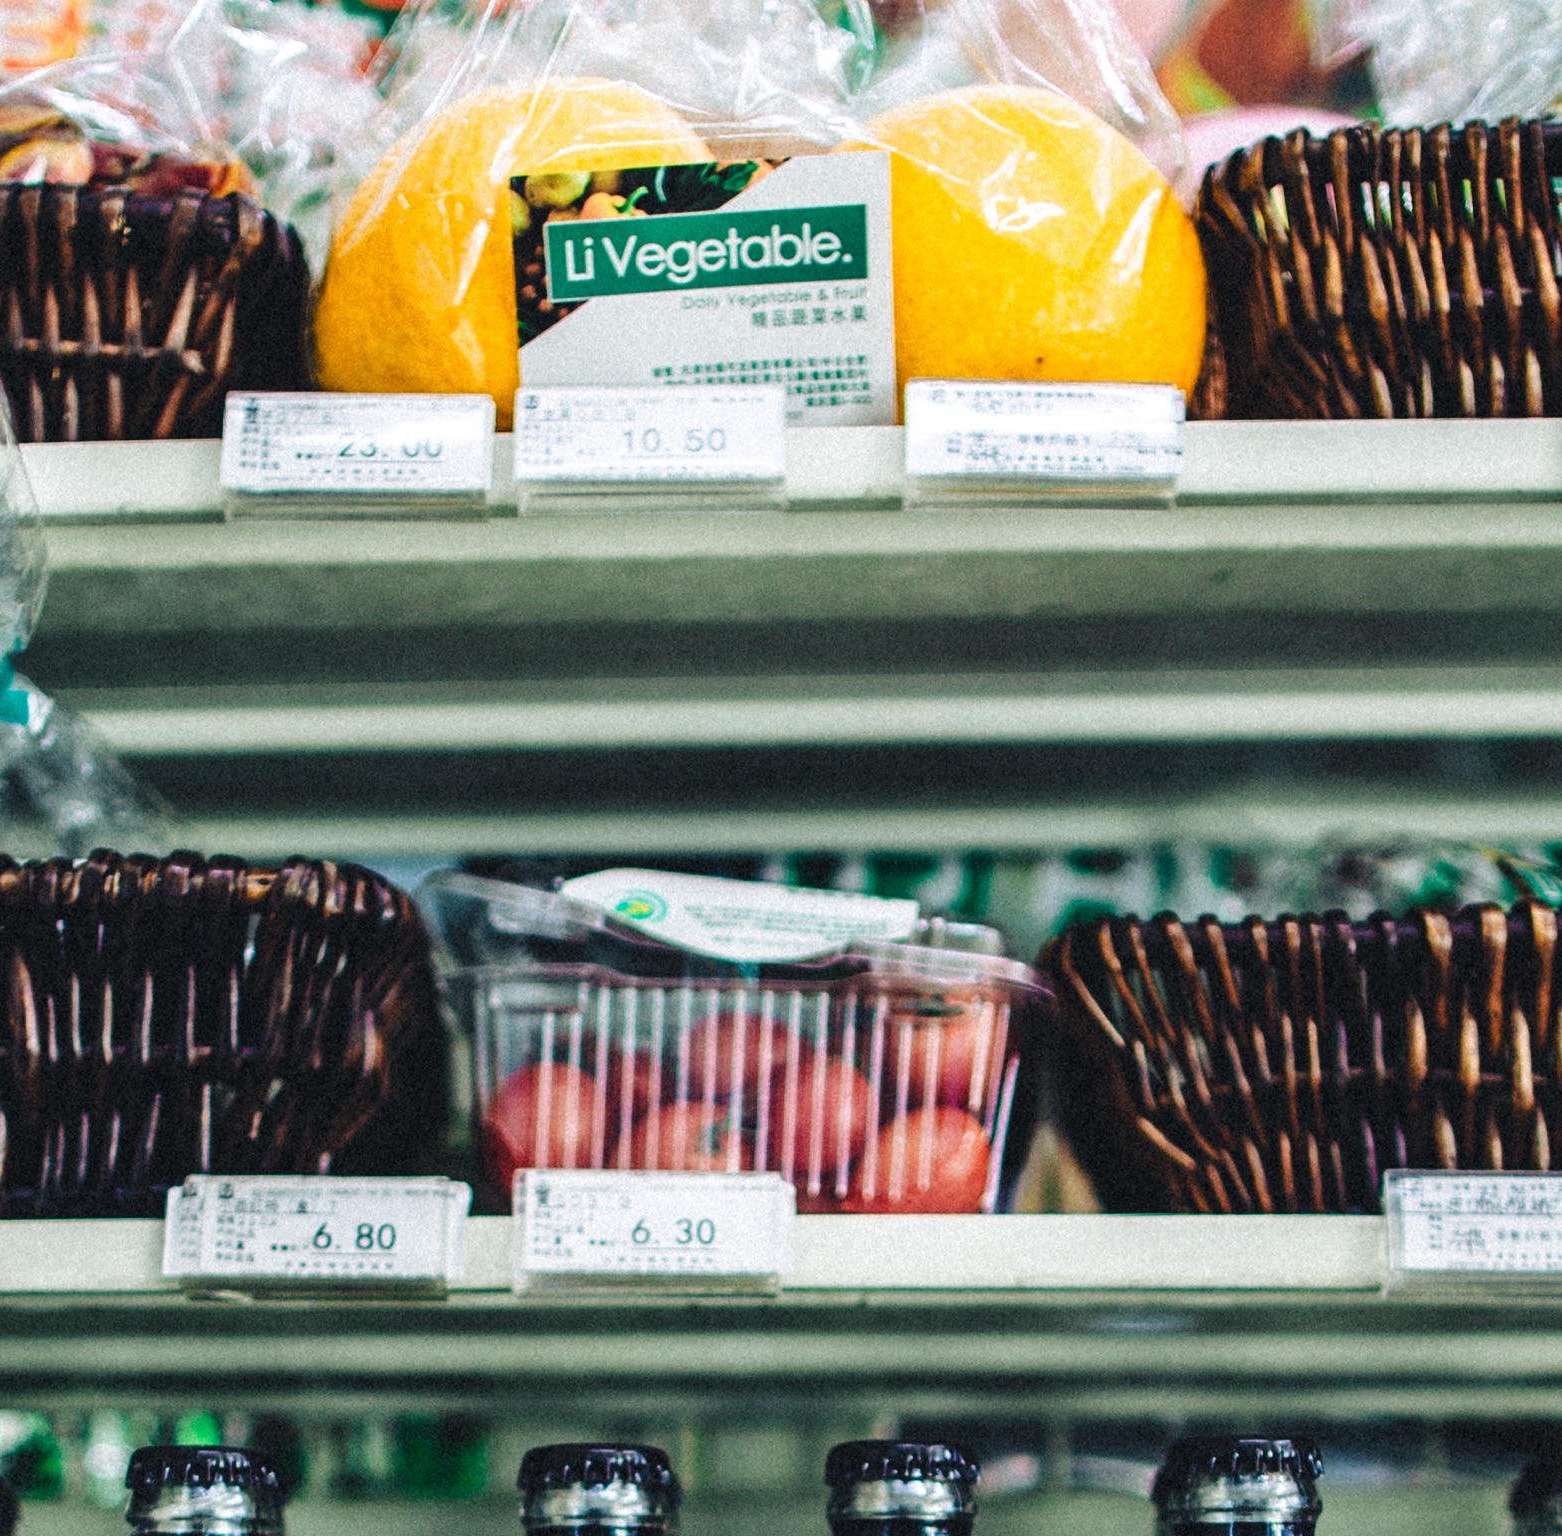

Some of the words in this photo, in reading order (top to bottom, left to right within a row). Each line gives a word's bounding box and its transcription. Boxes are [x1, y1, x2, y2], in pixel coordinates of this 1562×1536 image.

[565, 237, 595, 281] Li
[602, 222, 853, 284] Vegetable.
[726, 290, 812, 308] Vegetable
[818, 288, 828, 300] &
[833, 286, 867, 299] Fruit
[623, 427, 727, 453] 10.50
[313, 1222, 397, 1252] 6.80
[630, 1217, 717, 1248] 6.30
